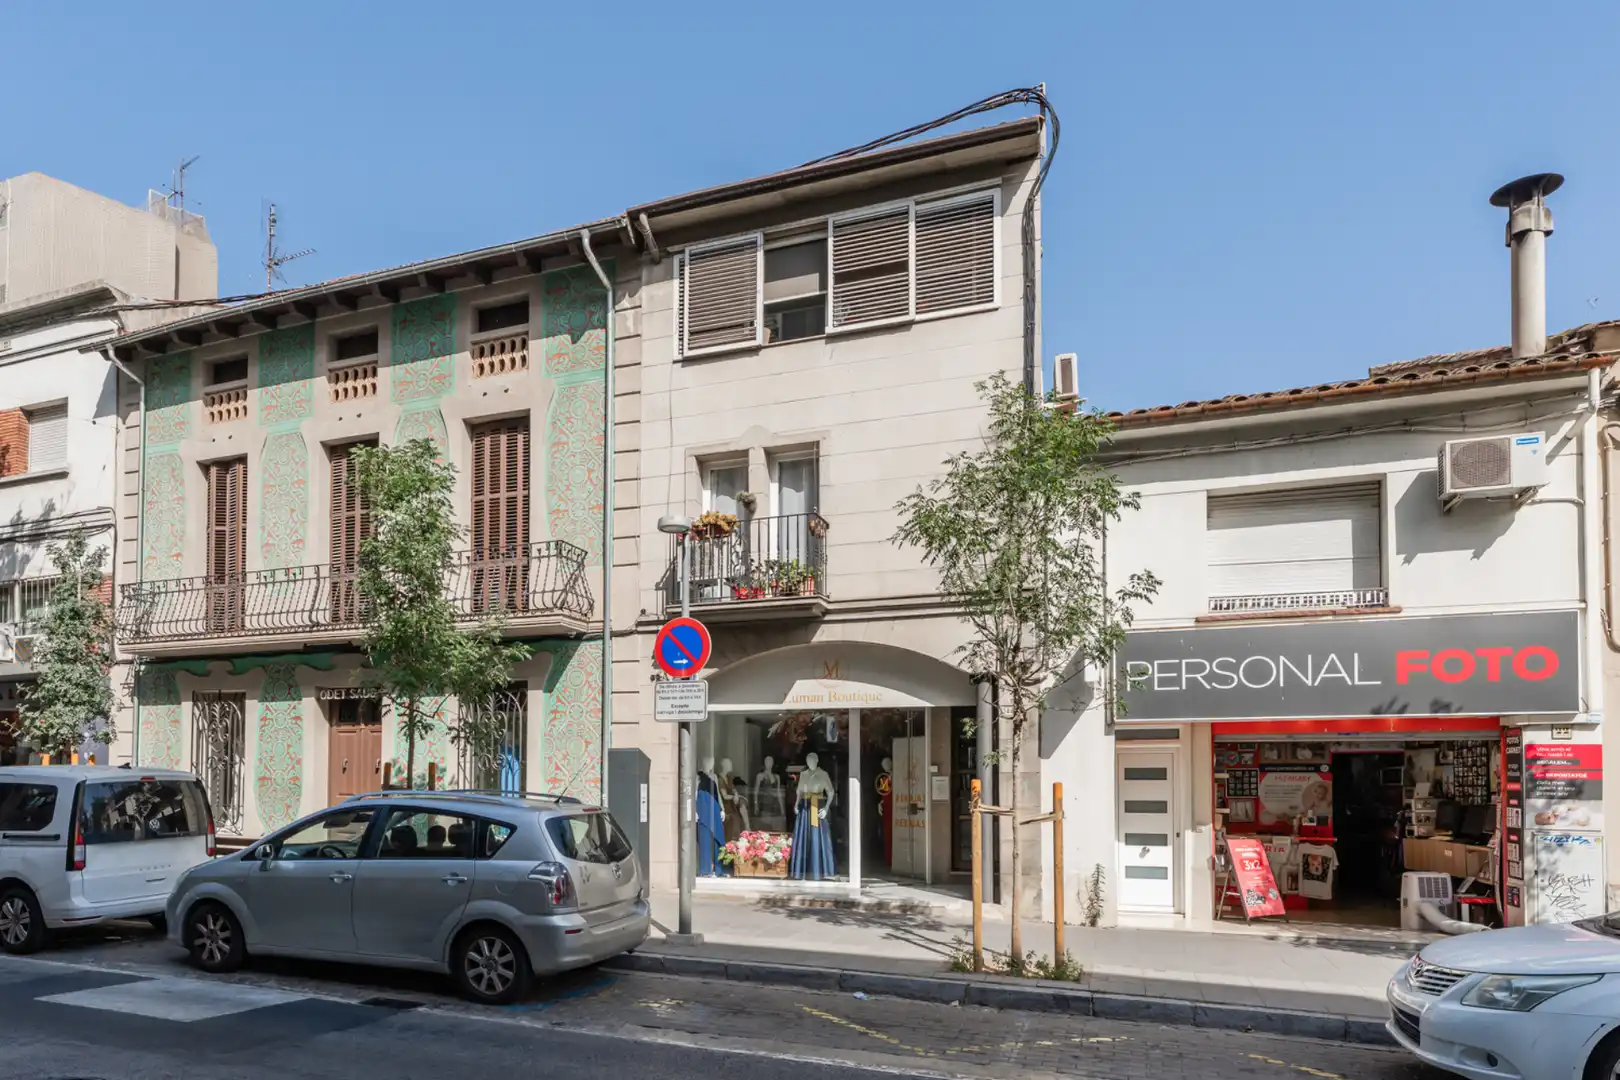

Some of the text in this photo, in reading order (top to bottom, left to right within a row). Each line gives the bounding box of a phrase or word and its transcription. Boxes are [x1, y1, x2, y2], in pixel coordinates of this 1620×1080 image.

[1126, 645, 1560, 691] PERSONAL FOTO
[828, 690, 883, 704] Boutique
[1243, 859, 1262, 870] 3x2
